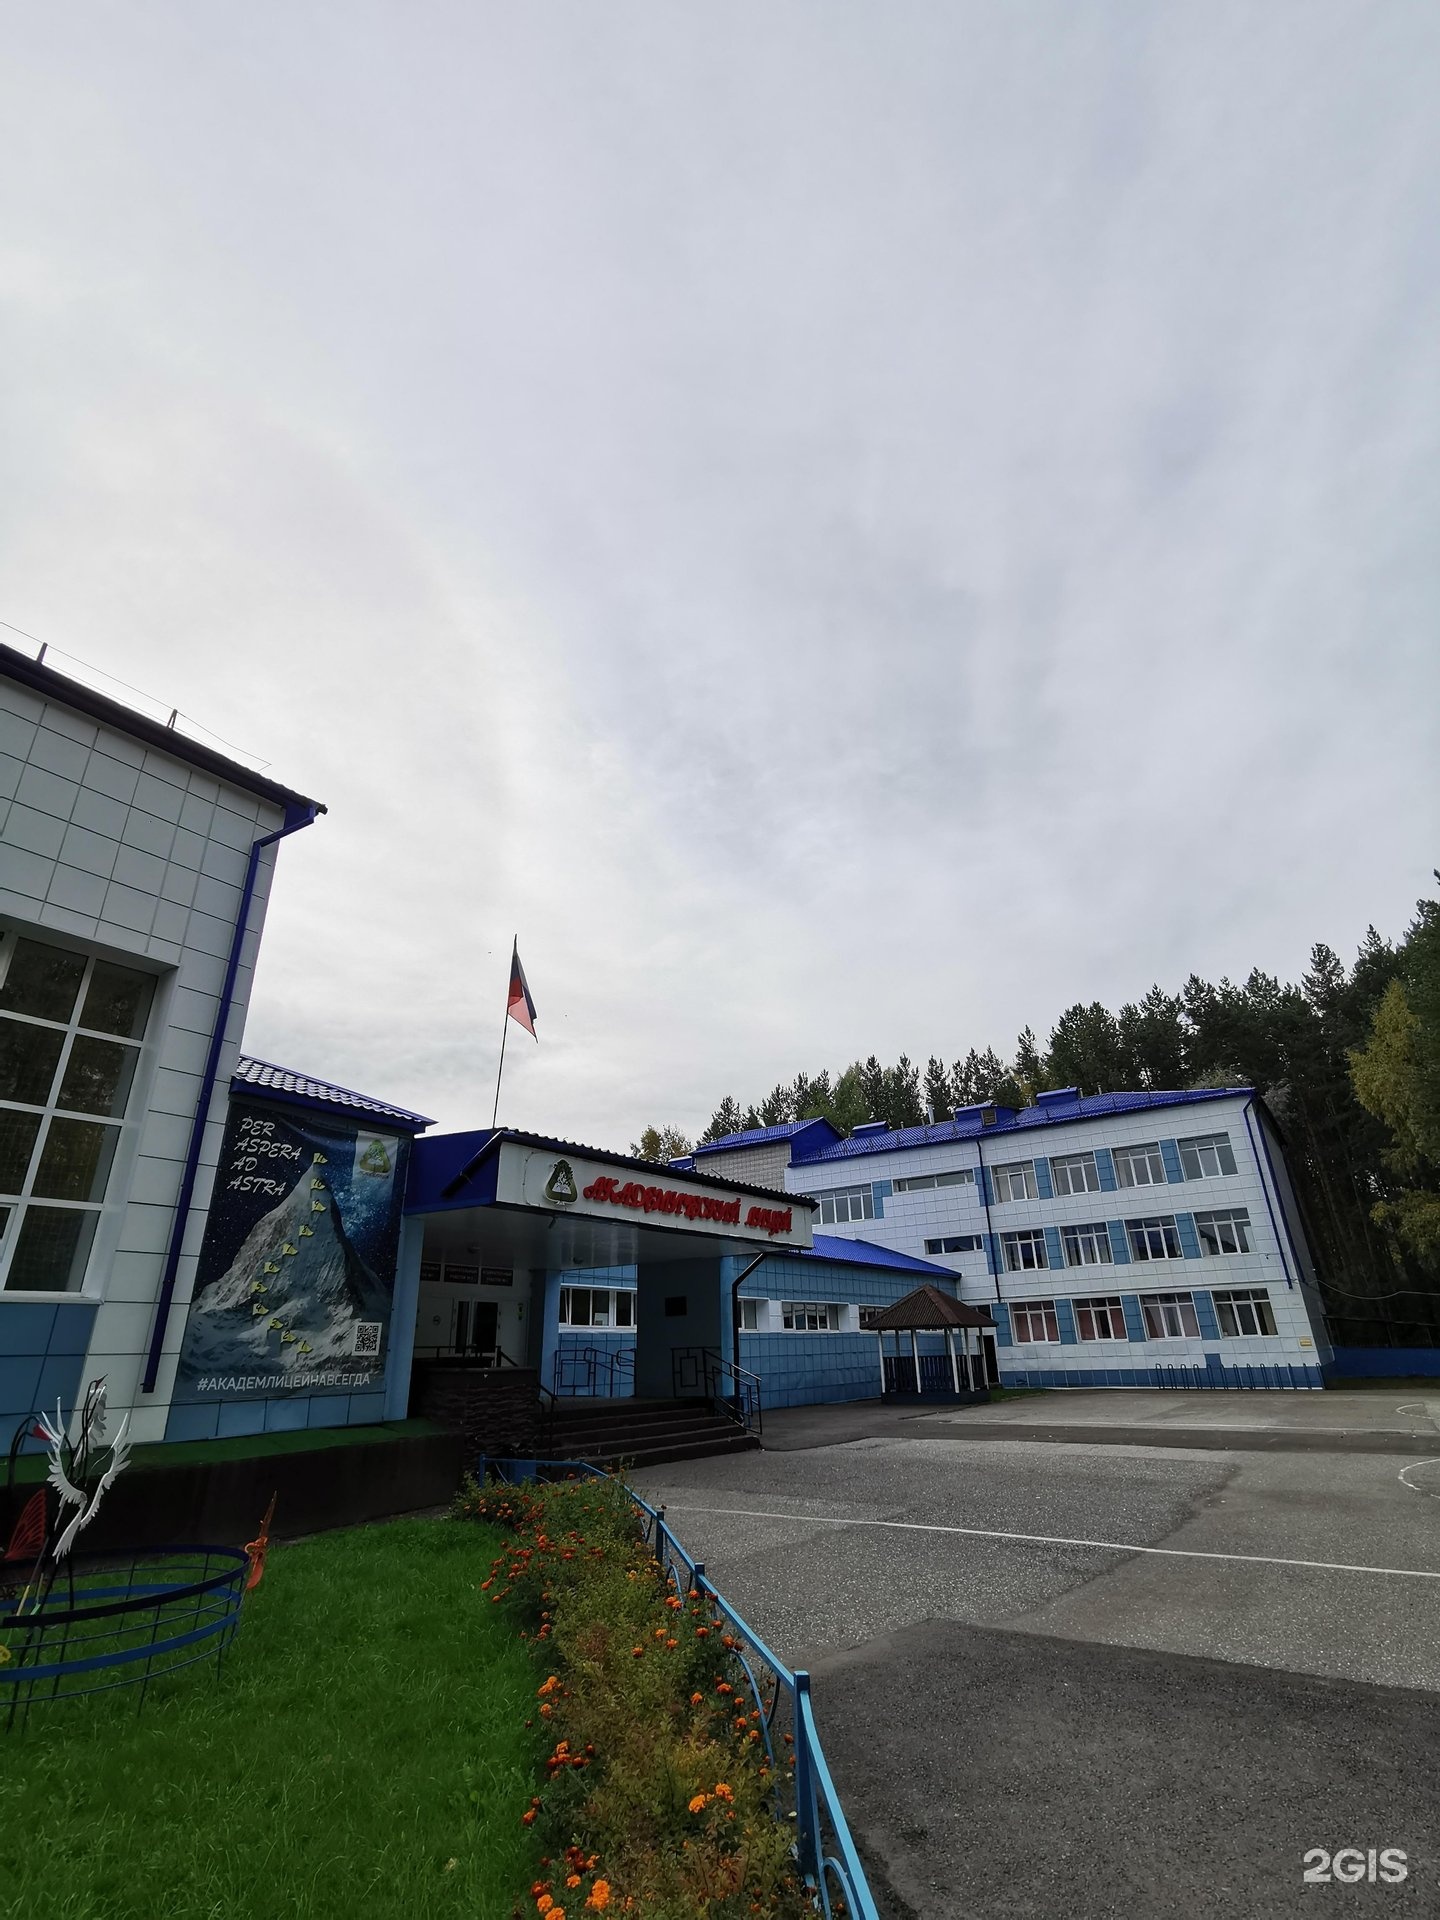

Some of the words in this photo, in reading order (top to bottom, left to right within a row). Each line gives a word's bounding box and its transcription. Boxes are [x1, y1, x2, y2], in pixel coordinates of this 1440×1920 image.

[240, 1117, 275, 1136] PER
[234, 1137, 302, 1160] ASPERA
[230, 1156, 258, 1171] AD
[226, 1175, 287, 1195] ASTRA
[197, 1372, 371, 1391] #АКАДЕМЛИЦЕЙНАВСЕГДА
